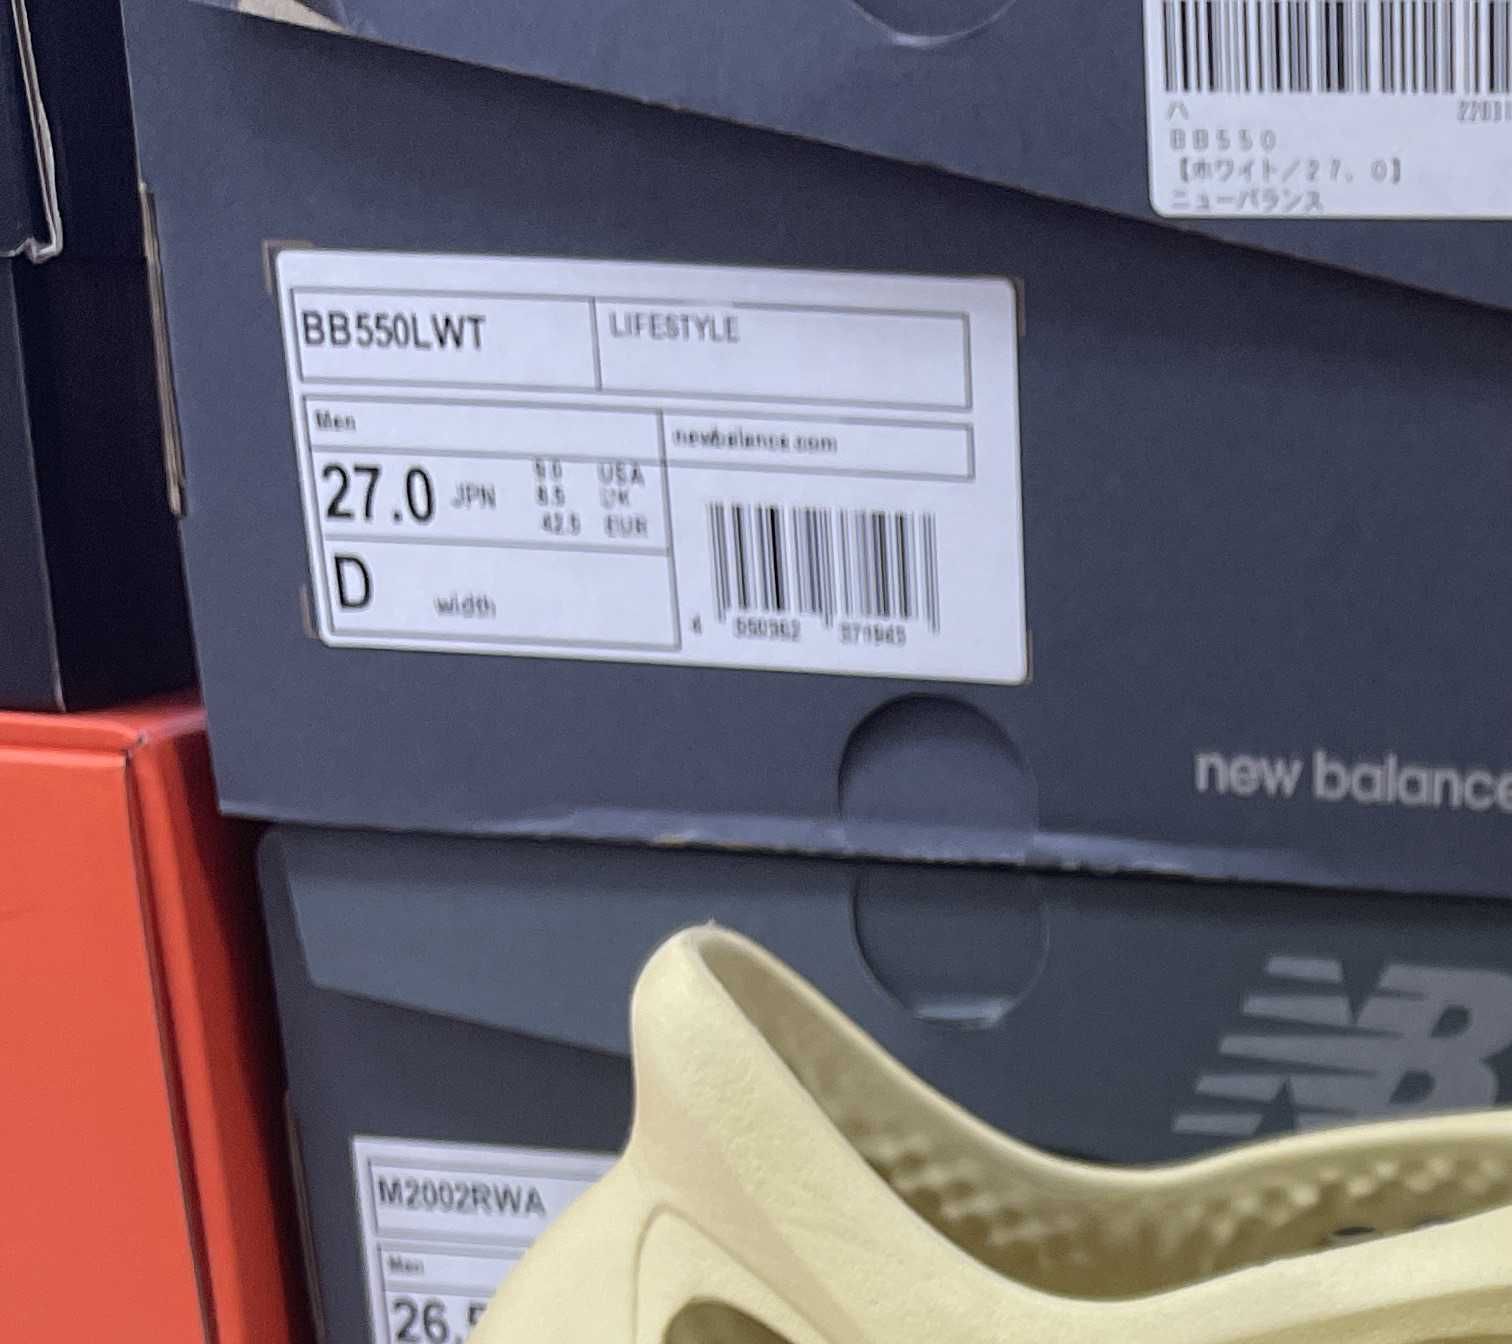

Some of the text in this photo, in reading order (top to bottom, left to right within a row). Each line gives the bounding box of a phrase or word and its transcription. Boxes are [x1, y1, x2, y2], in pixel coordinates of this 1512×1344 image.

[302, 310, 486, 350] BB550LWT
[609, 311, 739, 344] LIFESTYLE
[315, 412, 356, 432] Men
[673, 426, 837, 453] newbalance.com
[321, 463, 496, 524] 27.0 JPN
[334, 553, 373, 609] D
[1195, 751, 1303, 798] new
[378, 1175, 547, 1217] M2002RWA
